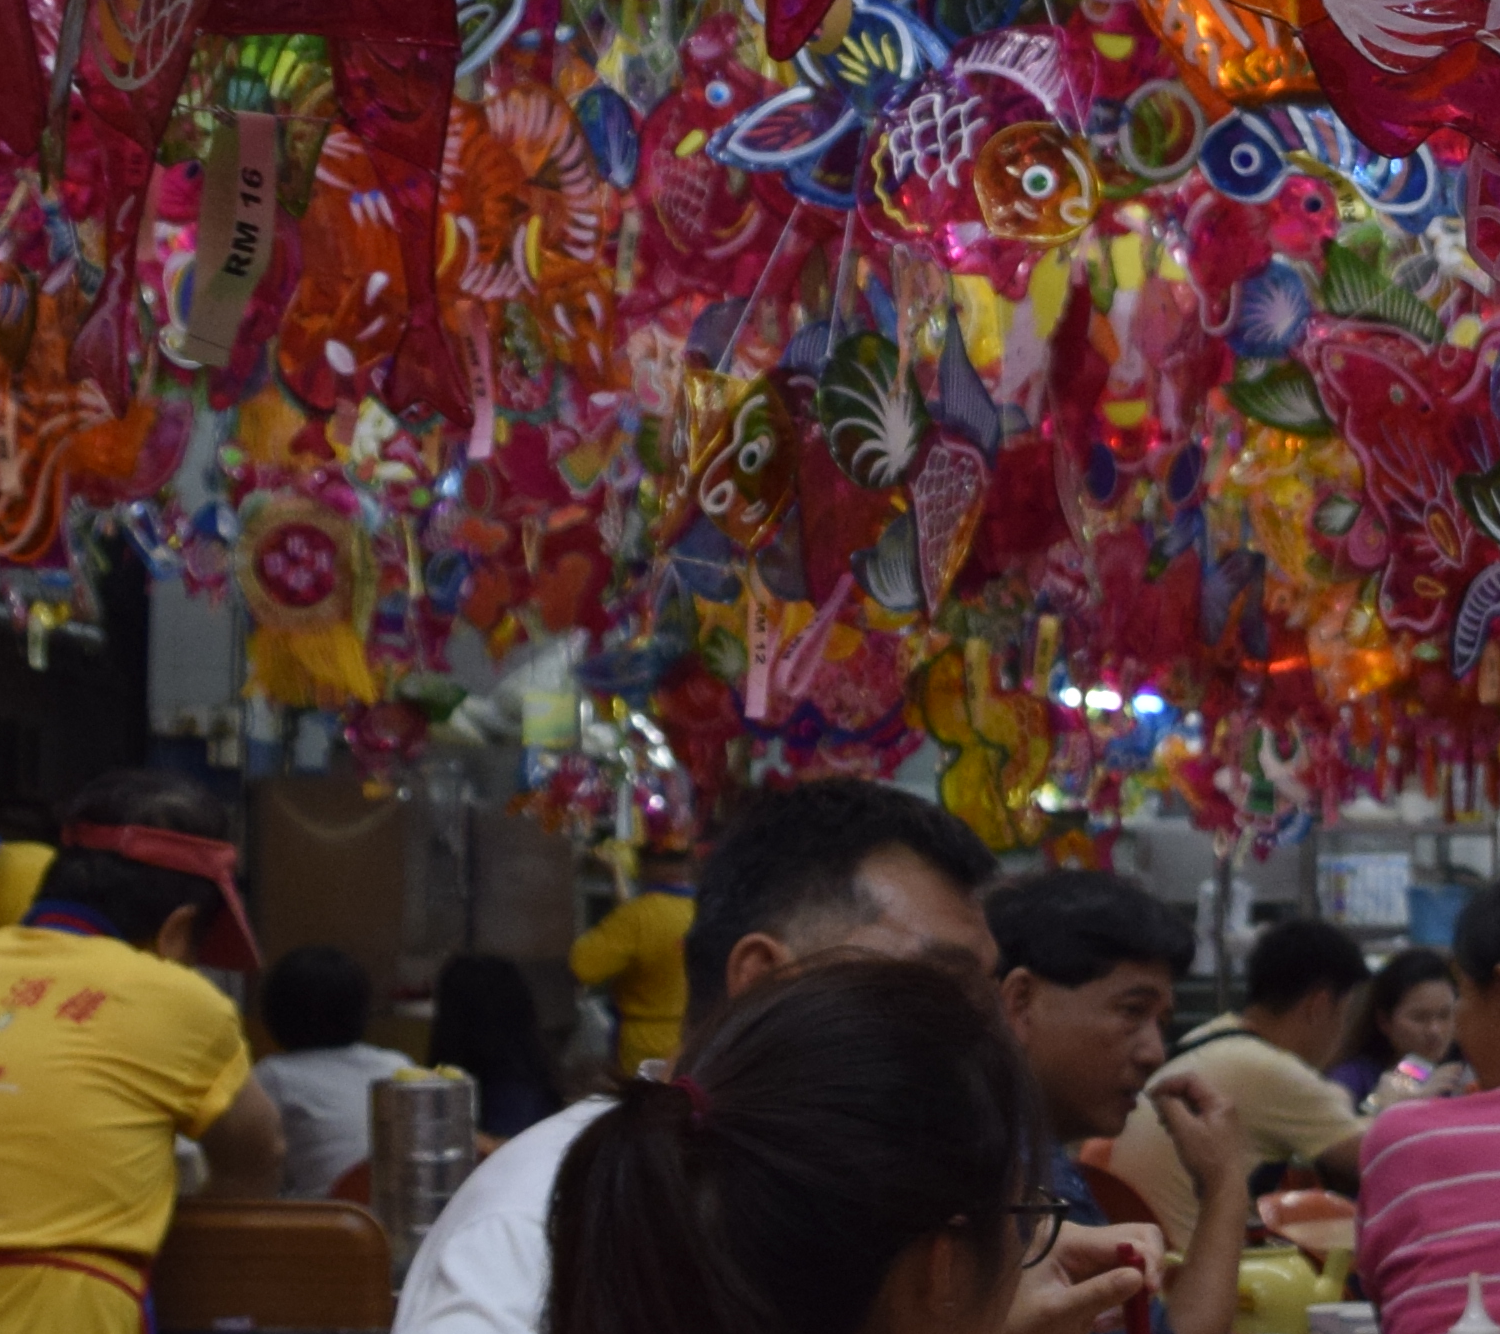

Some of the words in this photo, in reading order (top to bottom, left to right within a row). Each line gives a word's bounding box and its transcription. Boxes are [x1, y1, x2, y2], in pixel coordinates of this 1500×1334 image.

[234, 165, 264, 205] 16
[224, 213, 262, 279] RM
[755, 603, 767, 636] RM
[754, 640, 767, 665] 12
